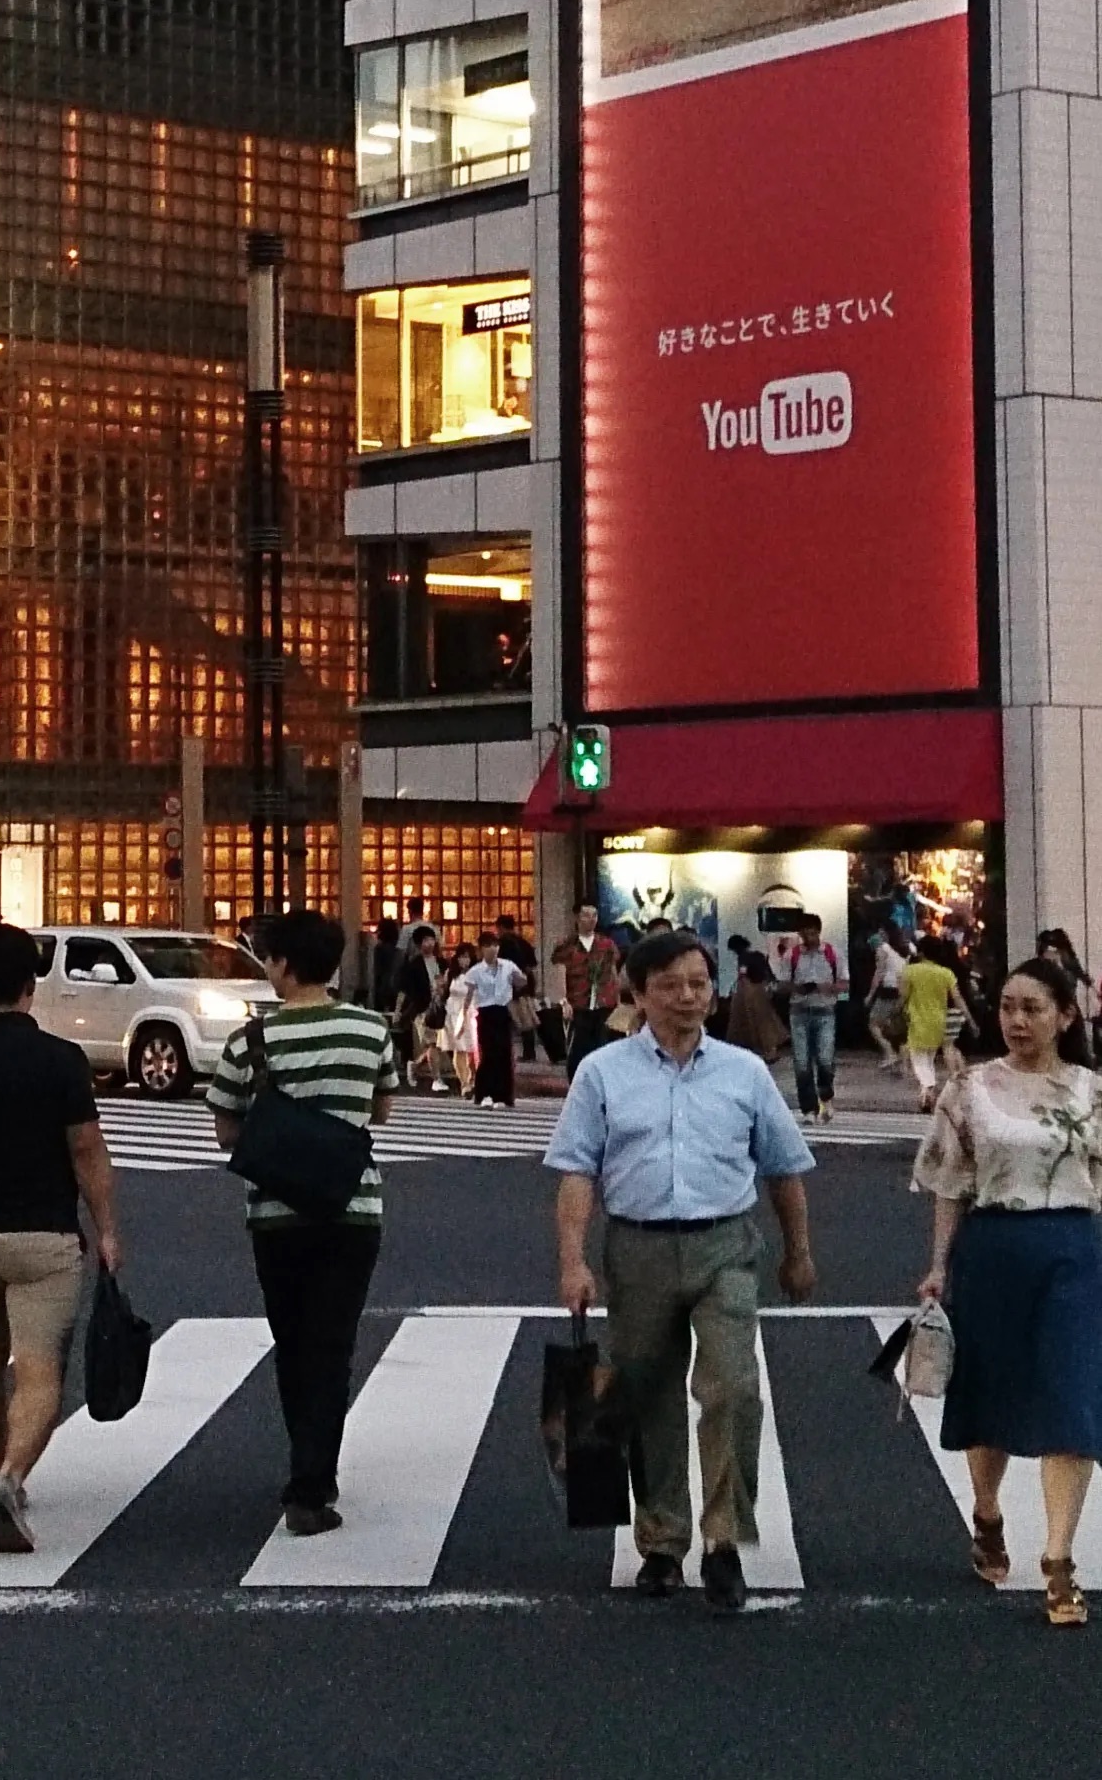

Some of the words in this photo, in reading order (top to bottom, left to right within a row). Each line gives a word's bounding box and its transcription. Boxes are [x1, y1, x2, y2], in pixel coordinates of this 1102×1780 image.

[657, 289, 895, 357] 好きなことで、生きていく
[701, 378, 849, 452] YouTube
[602, 835, 646, 850] SONY
